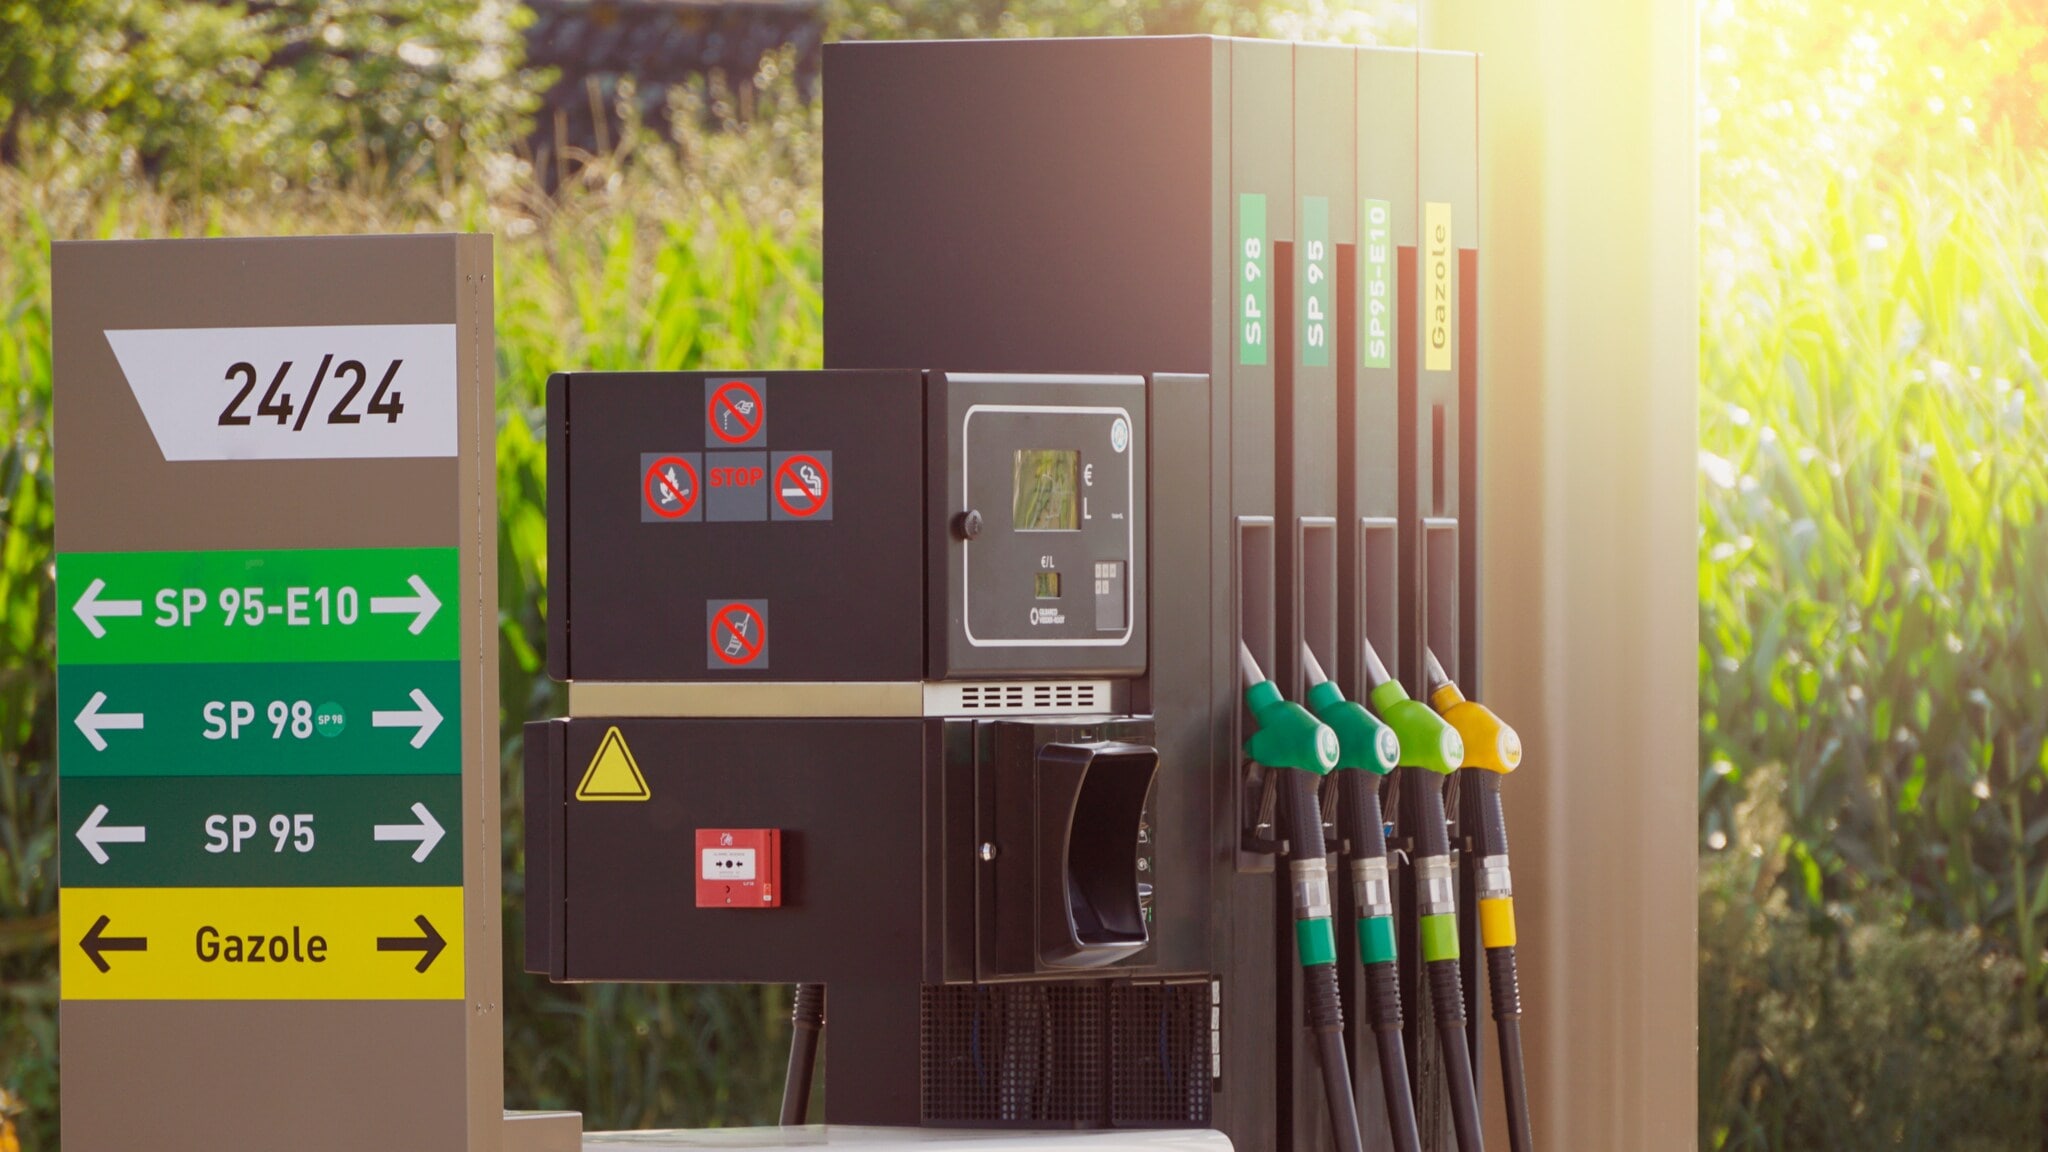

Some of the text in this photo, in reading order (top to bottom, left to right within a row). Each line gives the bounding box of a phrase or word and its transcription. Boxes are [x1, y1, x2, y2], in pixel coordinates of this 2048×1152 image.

[1245, 237, 1262, 346] SP 98
[1307, 239, 1324, 347] SP 95
[1369, 206, 1386, 359] SP95-E10
[1432, 224, 1446, 349] Gazole
[218, 353, 404, 431] 24/24
[709, 466, 764, 488] STOP
[1083, 463, 1093, 487] €
[1083, 496, 1092, 520] L
[1041, 555, 1055, 568] €/L
[155, 586, 359, 627] SP 95-E10
[202, 700, 313, 740] SP 98
[318, 714, 343, 725] SP 98
[204, 813, 315, 853] SP 95
[196, 925, 328, 963] Gazole
